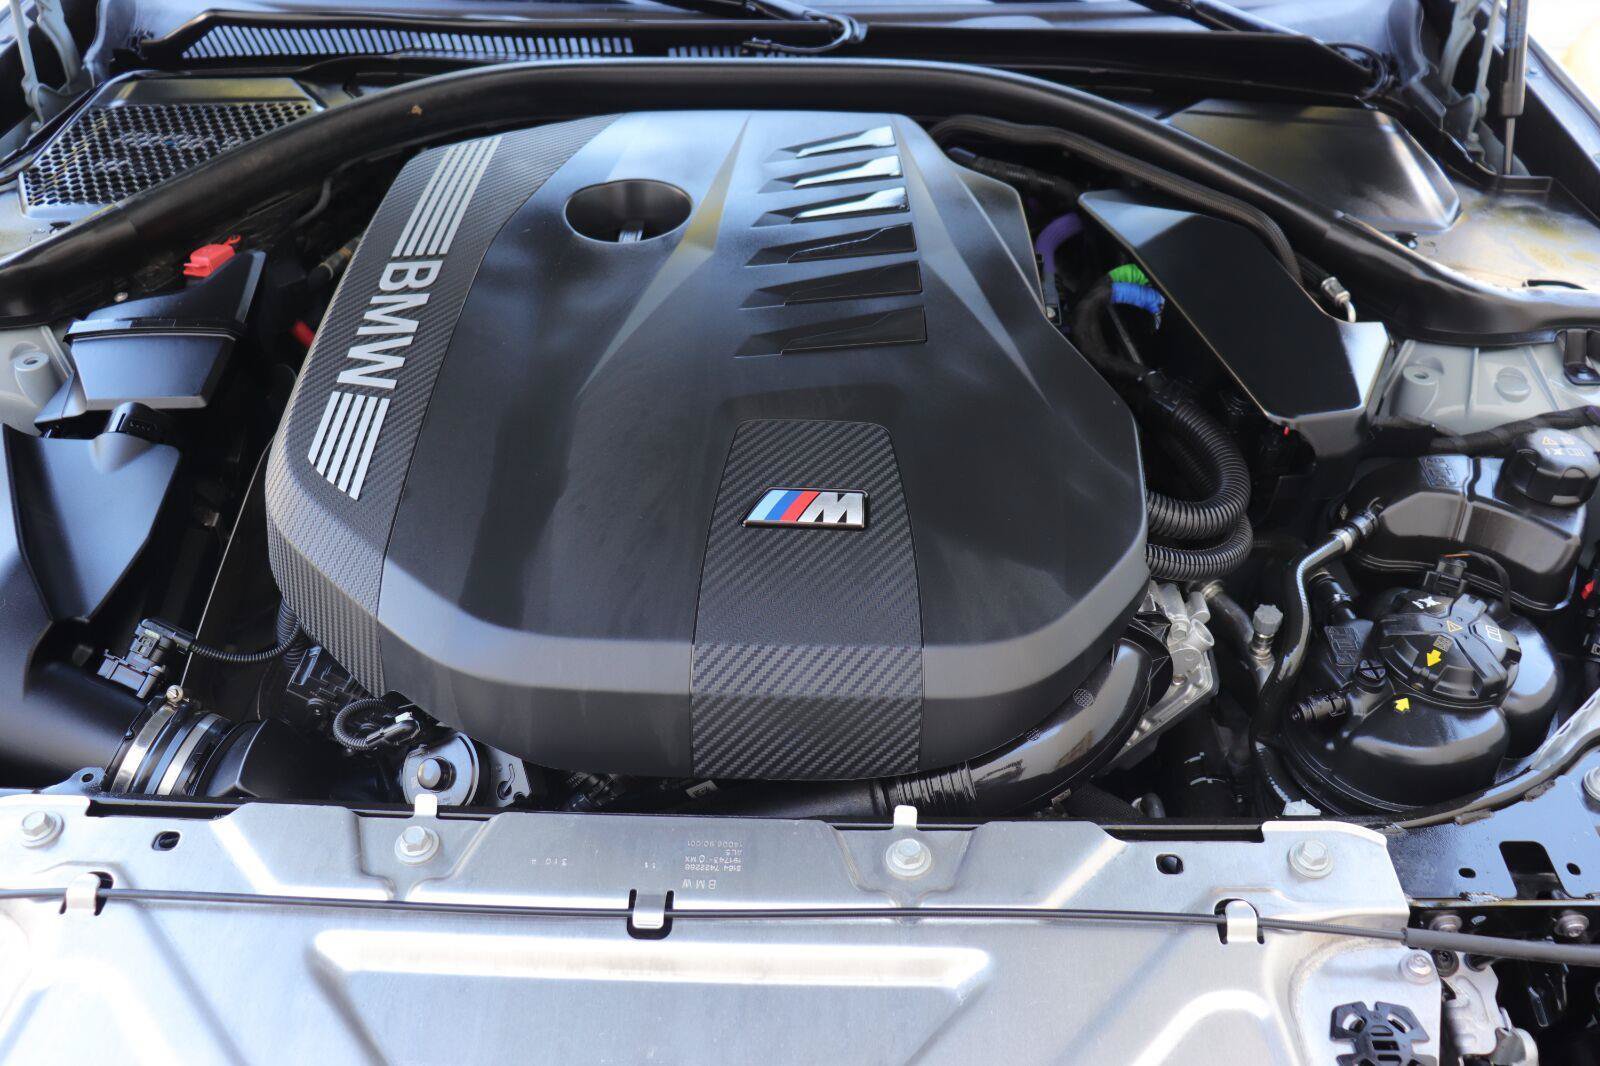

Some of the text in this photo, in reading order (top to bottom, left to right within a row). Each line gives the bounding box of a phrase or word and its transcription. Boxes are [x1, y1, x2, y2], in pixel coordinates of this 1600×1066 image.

[337, 260, 443, 389] BMW
[797, 491, 864, 524] M
[682, 879, 717, 890] BMW
